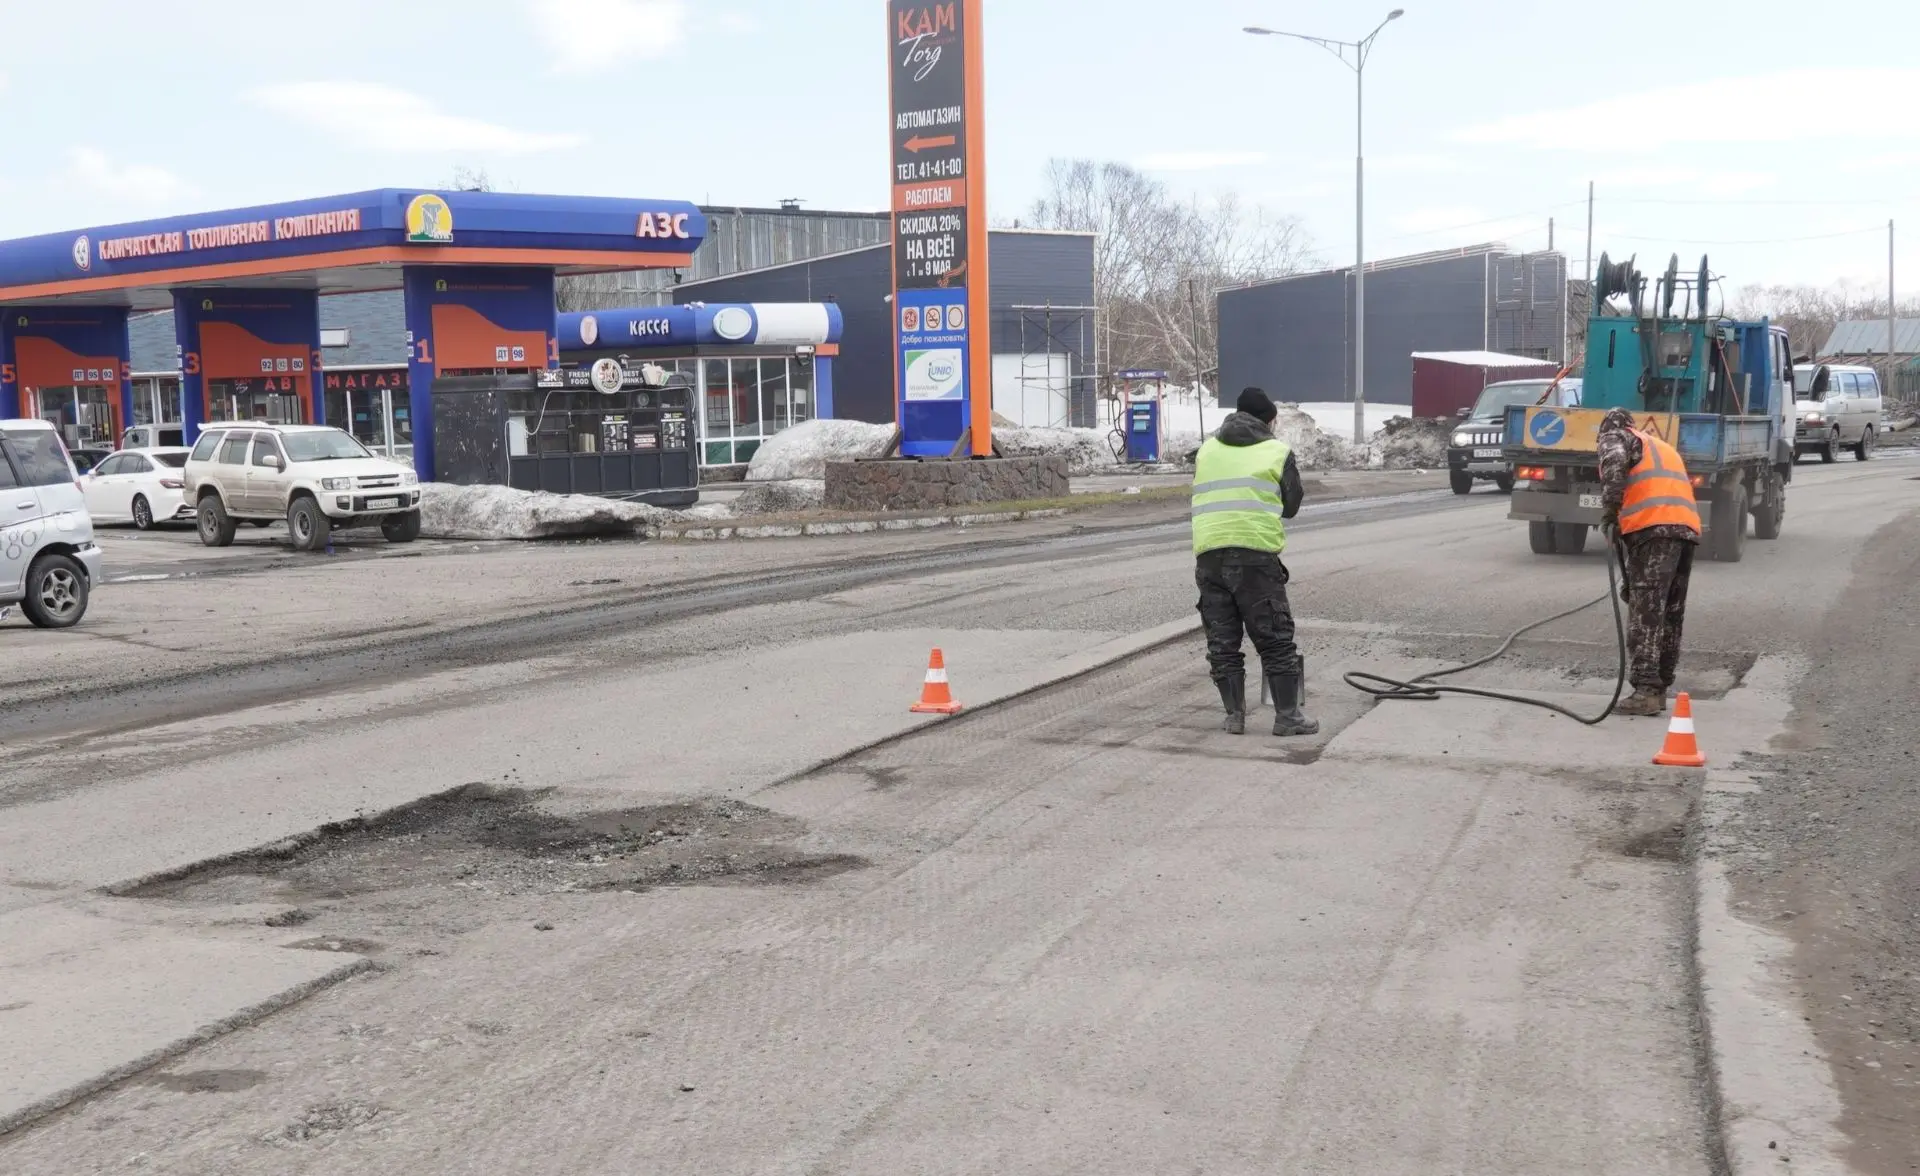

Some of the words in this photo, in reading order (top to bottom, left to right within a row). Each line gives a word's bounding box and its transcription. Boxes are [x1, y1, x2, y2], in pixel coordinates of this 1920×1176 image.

[898, 32, 942, 81] Torg
[896, 106, 961, 129] АВТОМАГАЗИН
[897, 163, 917, 181] ТЕЛ.
[919, 158, 962, 178] 41-41-00
[905, 187, 952, 206] РАБОТАЕМ
[636, 211, 689, 239] АЗС
[900, 215, 937, 235] СКИДКА
[939, 213, 961, 231] 20%
[98, 231, 184, 260] КАМЧАТСКАЯ
[188, 220, 270, 250] ТОПЛИВНАЯ
[275, 208, 360, 241] КОМПАНИЯ
[906, 240, 924, 260] НА
[927, 236, 955, 257] ВСЁ!
[911, 262, 916, 276] 1
[925, 261, 931, 276] 9
[932, 260, 951, 275] МАЯ
[629, 318, 669, 337] КАССА
[901, 335, 922, 345] Добро
[924, 333, 966, 343] пожаловать!
[416, 338, 433, 364] 1
[497, 348, 508, 360] ДТ
[512, 347, 524, 359] 98
[185, 352, 200, 374] 3
[261, 360, 272, 370] 92
[293, 359, 303, 369] 80
[1, 363, 16, 383] 5
[103, 370, 113, 379] 92
[327, 372, 410, 389] МАГАЗ
